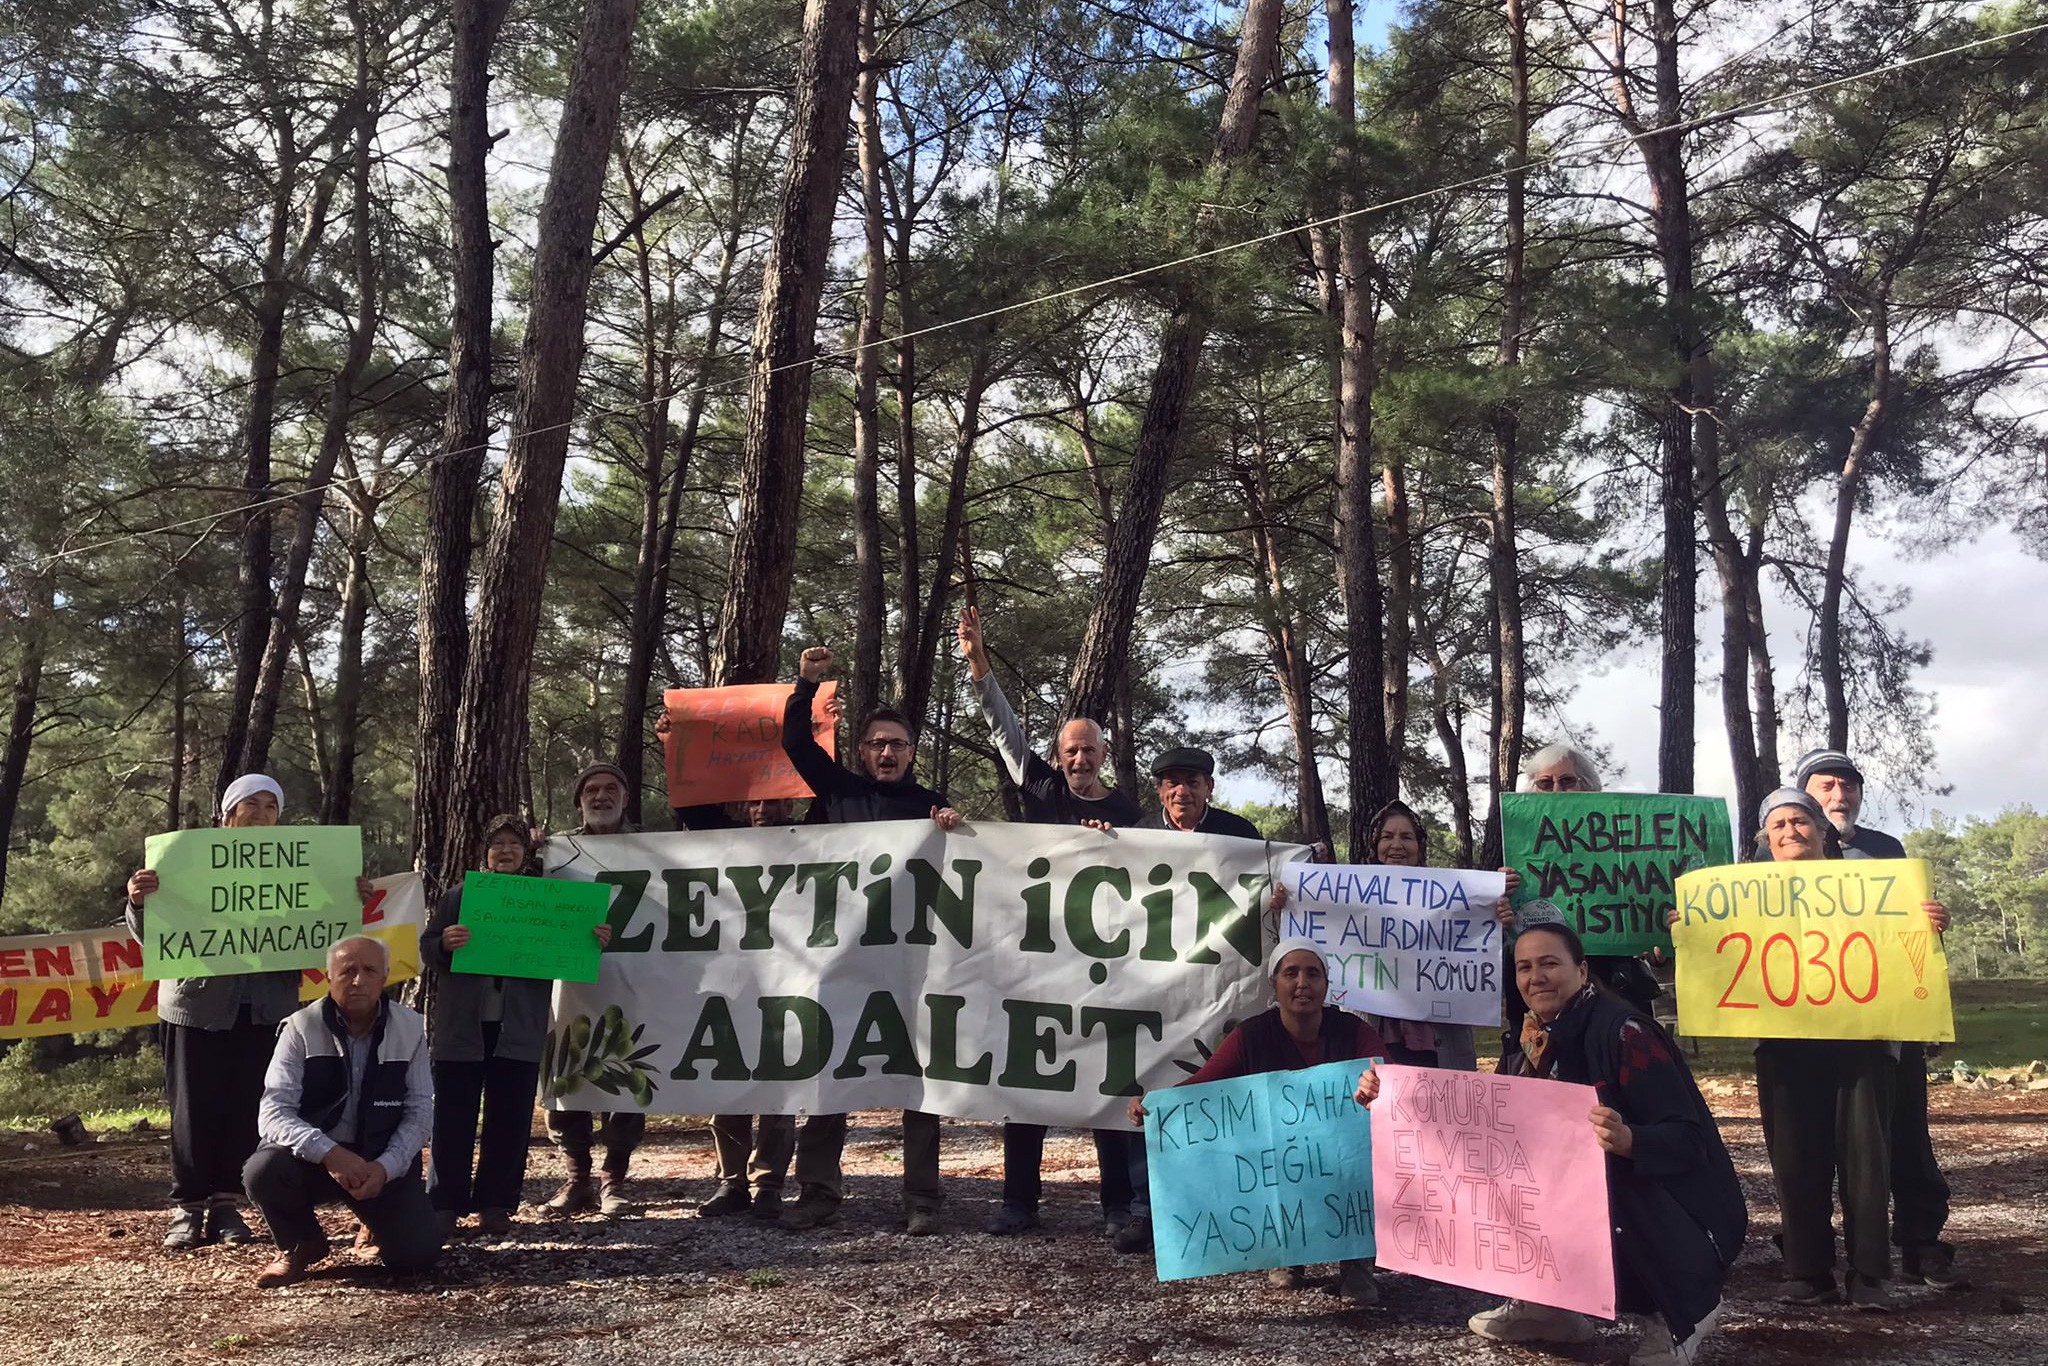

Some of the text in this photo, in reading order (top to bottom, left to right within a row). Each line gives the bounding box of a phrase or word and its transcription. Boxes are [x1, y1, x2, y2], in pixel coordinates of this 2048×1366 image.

[211, 840, 310, 869] DİRENE
[1533, 811, 1708, 854] AKBELEN
[211, 882, 310, 913] DİRENE
[594, 852, 1271, 986] ZEYTİN İÇİN
[1298, 871, 1470, 911] KAHVALTIDA
[1683, 873, 1908, 926] KÖMÜRSÜZ
[1289, 910, 1327, 944] NE
[1416, 956, 1497, 993] KÖMÜR
[1715, 931, 1879, 1010] 2030
[670, 990, 1162, 1097] ADALET
[1156, 1089, 1256, 1152] KESİM
[1390, 1073, 1515, 1134] KÖMÜRE
[1393, 1130, 1536, 1183] ELVEDA
[1173, 1199, 1307, 1261] YAŞAM
[1392, 1173, 1541, 1232] ZEYTİNE
[1391, 1214, 1561, 1282] CAN FEDA
